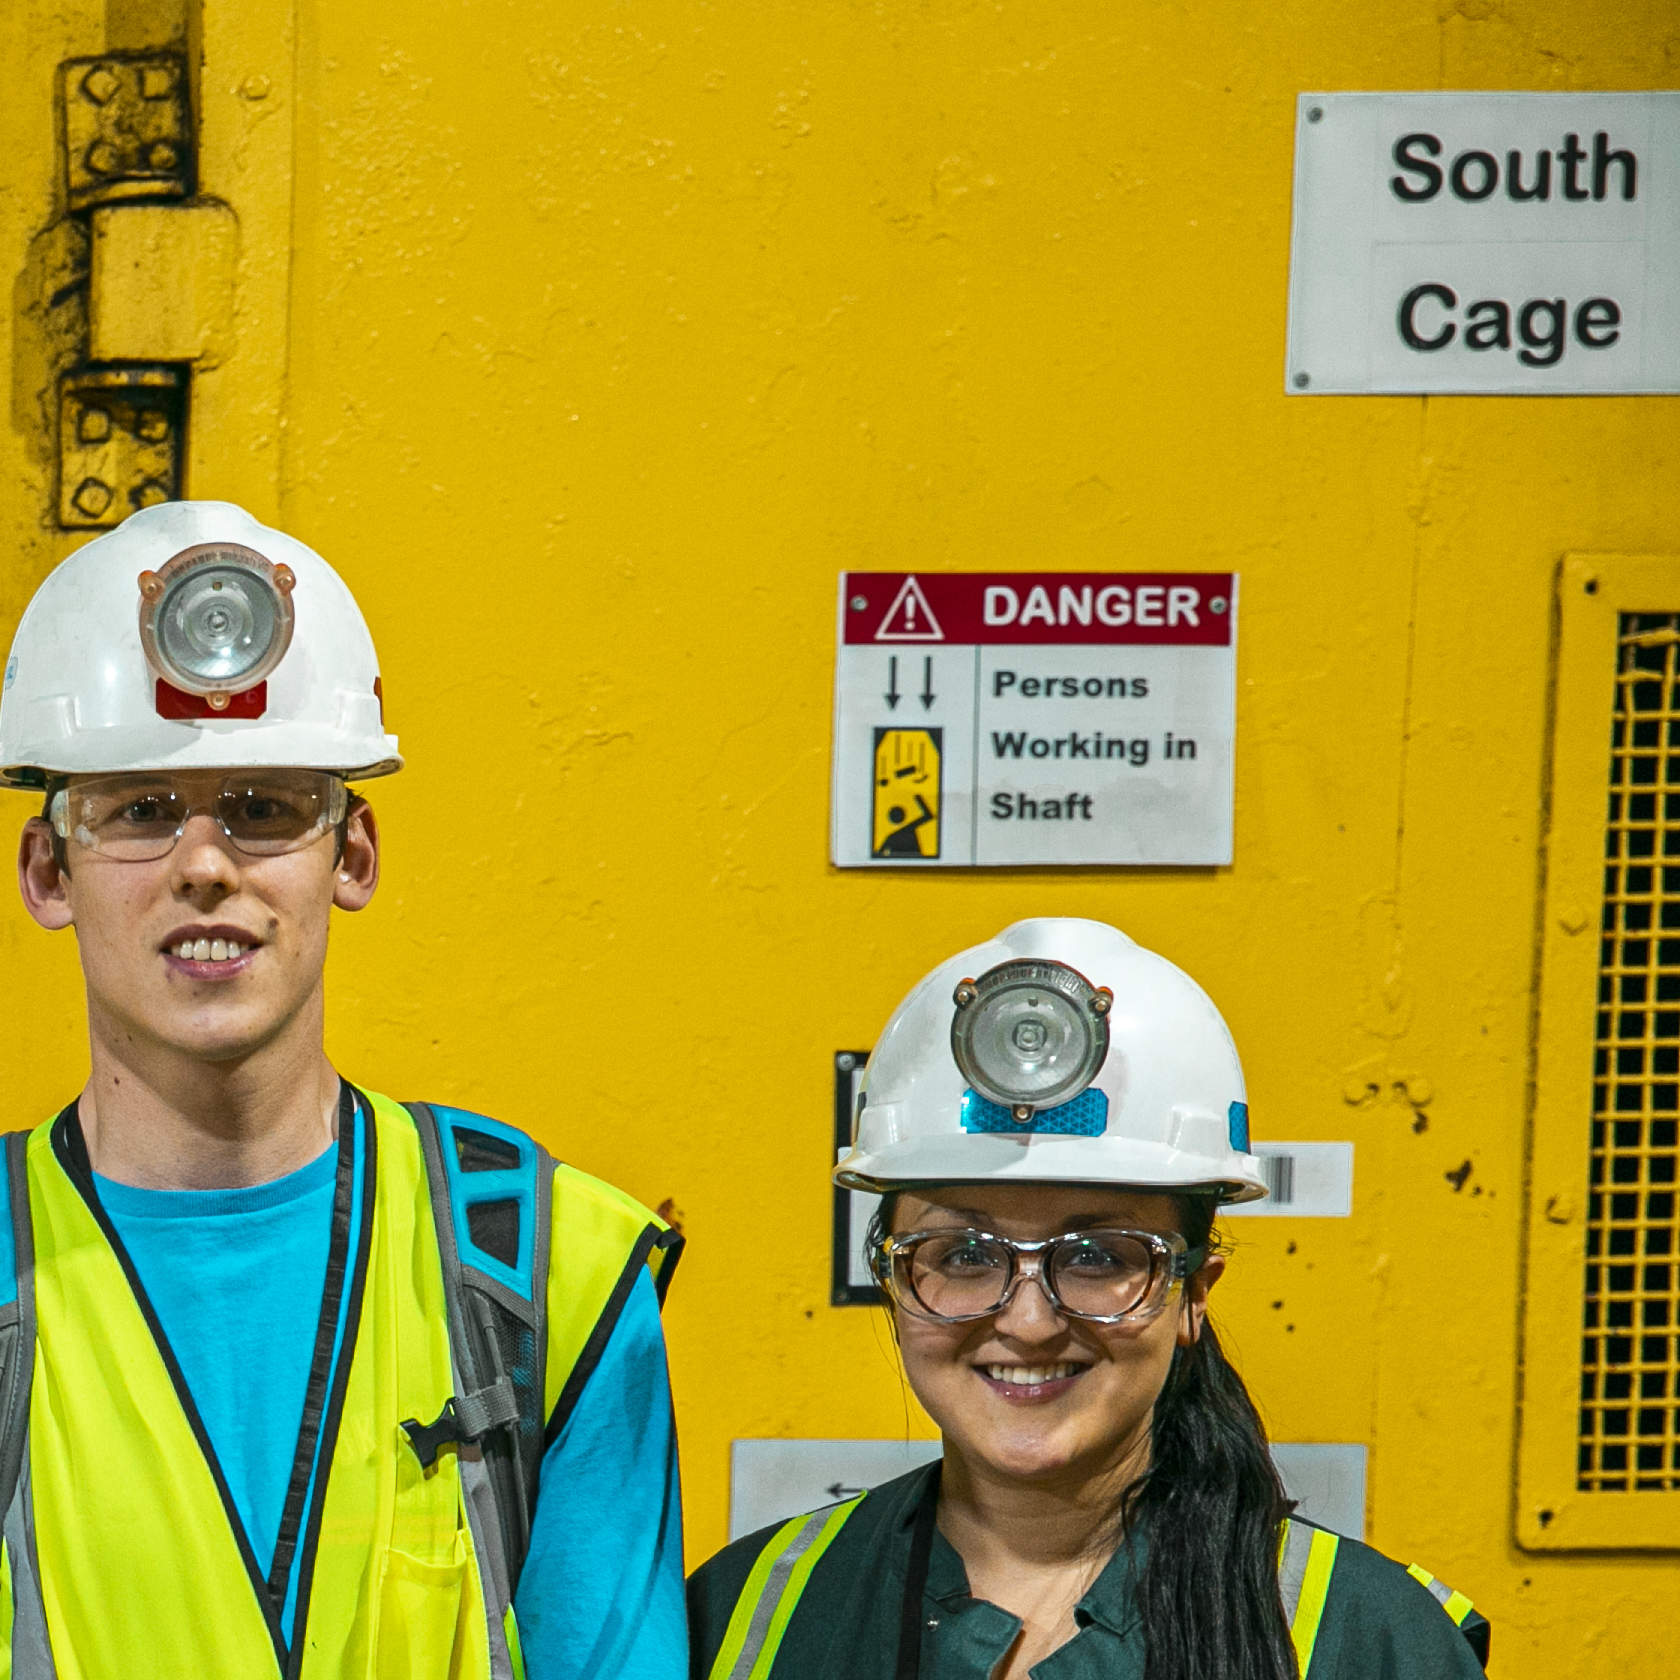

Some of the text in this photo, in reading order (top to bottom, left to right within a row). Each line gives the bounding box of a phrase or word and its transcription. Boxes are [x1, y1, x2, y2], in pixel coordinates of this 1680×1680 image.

[1390, 131, 1638, 203] South
[1397, 283, 1621, 367] Cage
[983, 586, 1200, 627] DANGER
[992, 670, 1149, 699] Persons
[991, 731, 1197, 765] Working in
[990, 791, 1093, 821] Shaft
